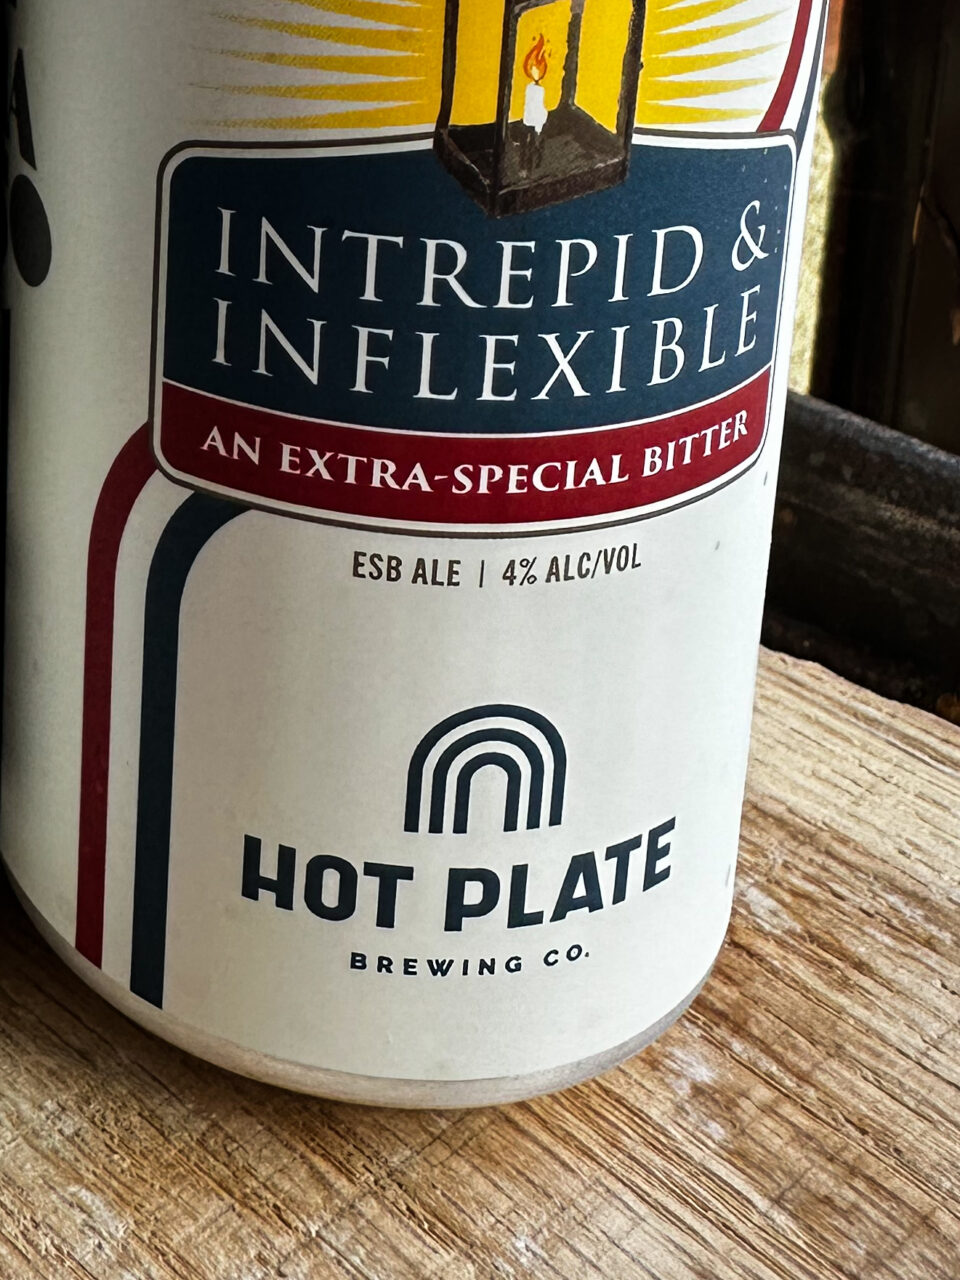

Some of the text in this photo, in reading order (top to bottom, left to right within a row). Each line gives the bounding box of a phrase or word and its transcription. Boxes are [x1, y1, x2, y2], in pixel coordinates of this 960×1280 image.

[214, 200, 770, 309] INTREPID &
[211, 284, 761, 401] INFLEXIBLE
[201, 410, 748, 495] AN EXTRA-SPECIAL BITTER
[352, 551, 403, 583] ESB
[410, 559, 461, 587] ALE
[502, 557, 537, 587] 4%
[546, 543, 642, 583] ALC/VOL
[241, 816, 676, 932] HOT PLATE
[350, 944, 589, 977] BREWING CO.
